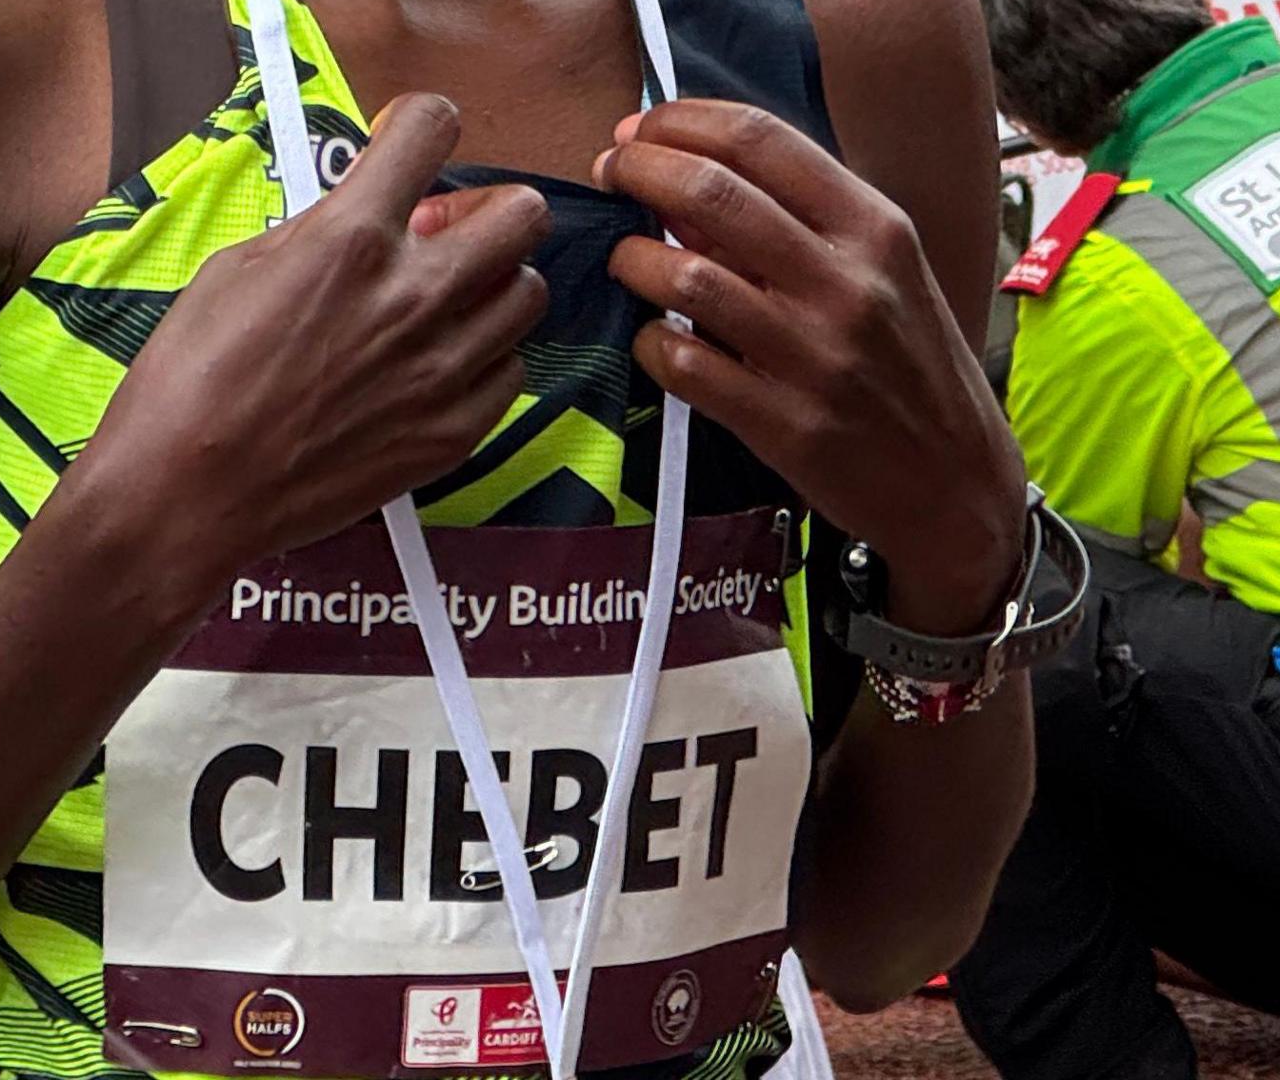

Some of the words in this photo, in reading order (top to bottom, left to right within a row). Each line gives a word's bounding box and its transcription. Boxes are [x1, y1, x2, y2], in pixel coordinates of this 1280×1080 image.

[1219, 177, 1272, 219] St
[675, 566, 762, 616] Society
[190, 726, 758, 903] CHEBET
[246, 1022, 292, 1035] HALFS
